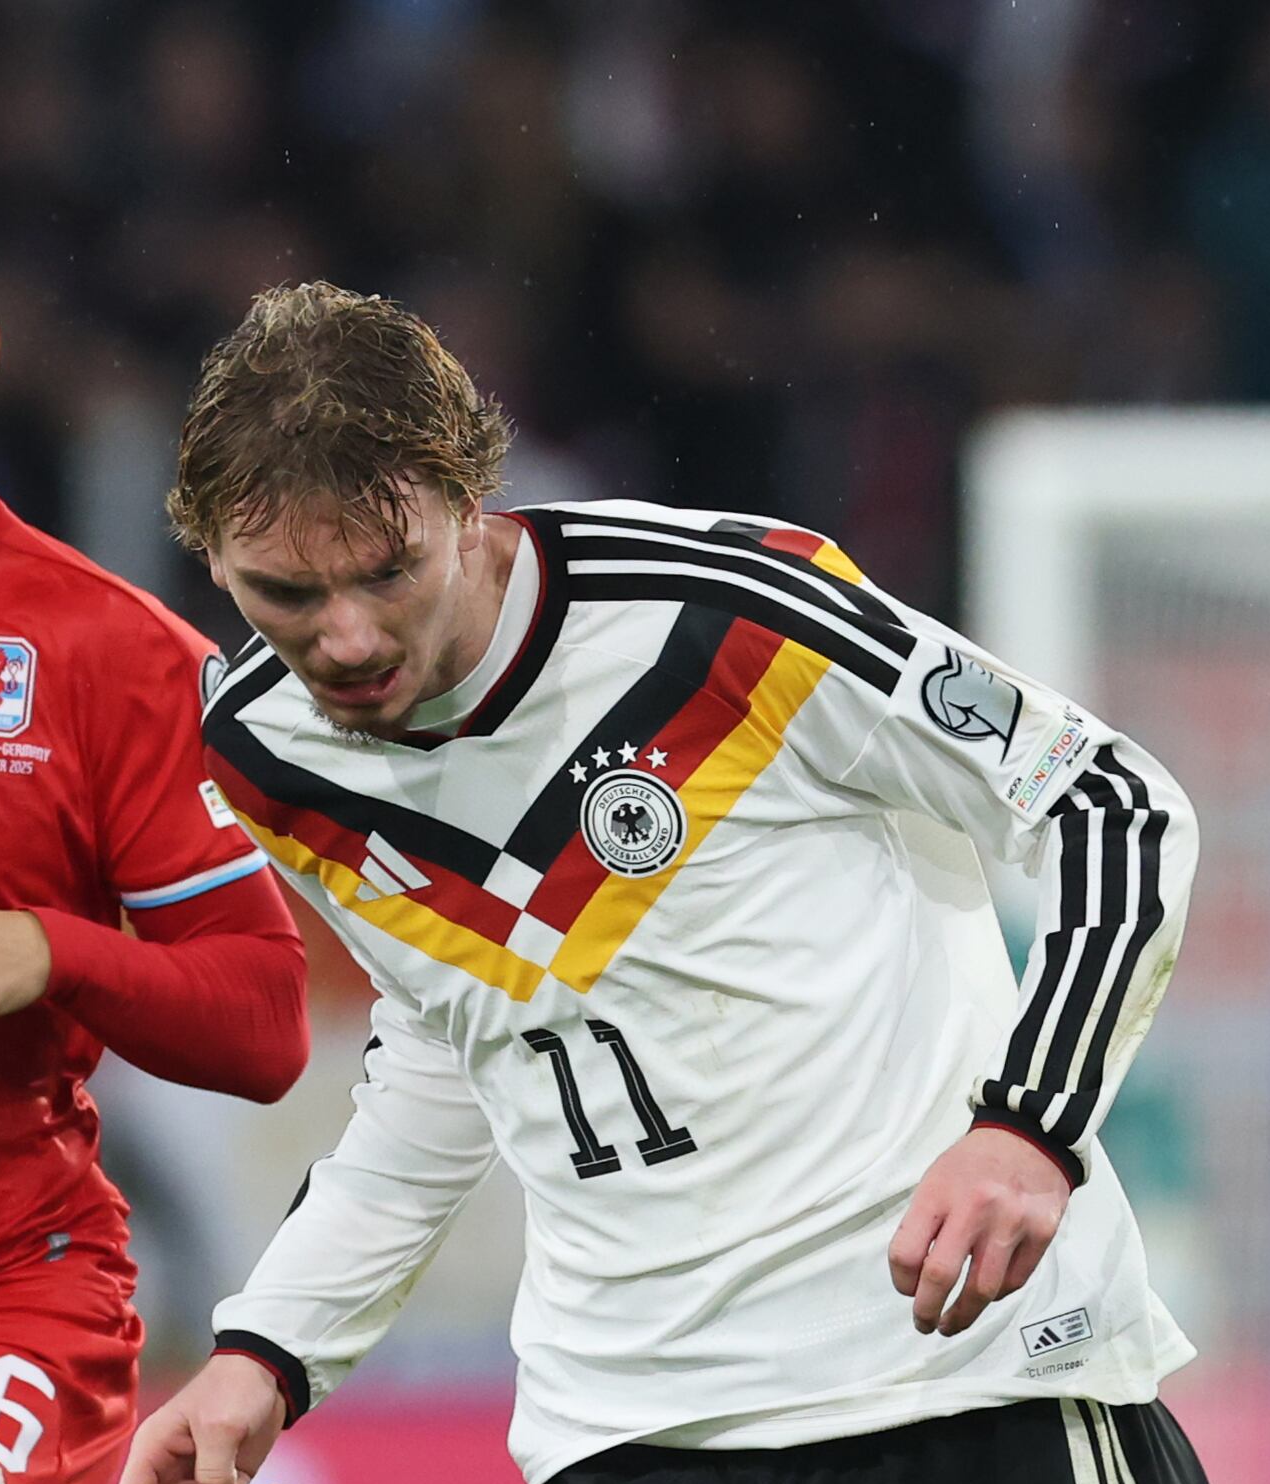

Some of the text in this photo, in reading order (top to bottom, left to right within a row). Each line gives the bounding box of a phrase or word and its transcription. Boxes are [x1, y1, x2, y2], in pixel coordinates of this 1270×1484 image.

[598, 786, 653, 810] DEUTSCHER
[1017, 725, 1079, 811] FOUNDATION
[520, 1019, 699, 1180] 11
